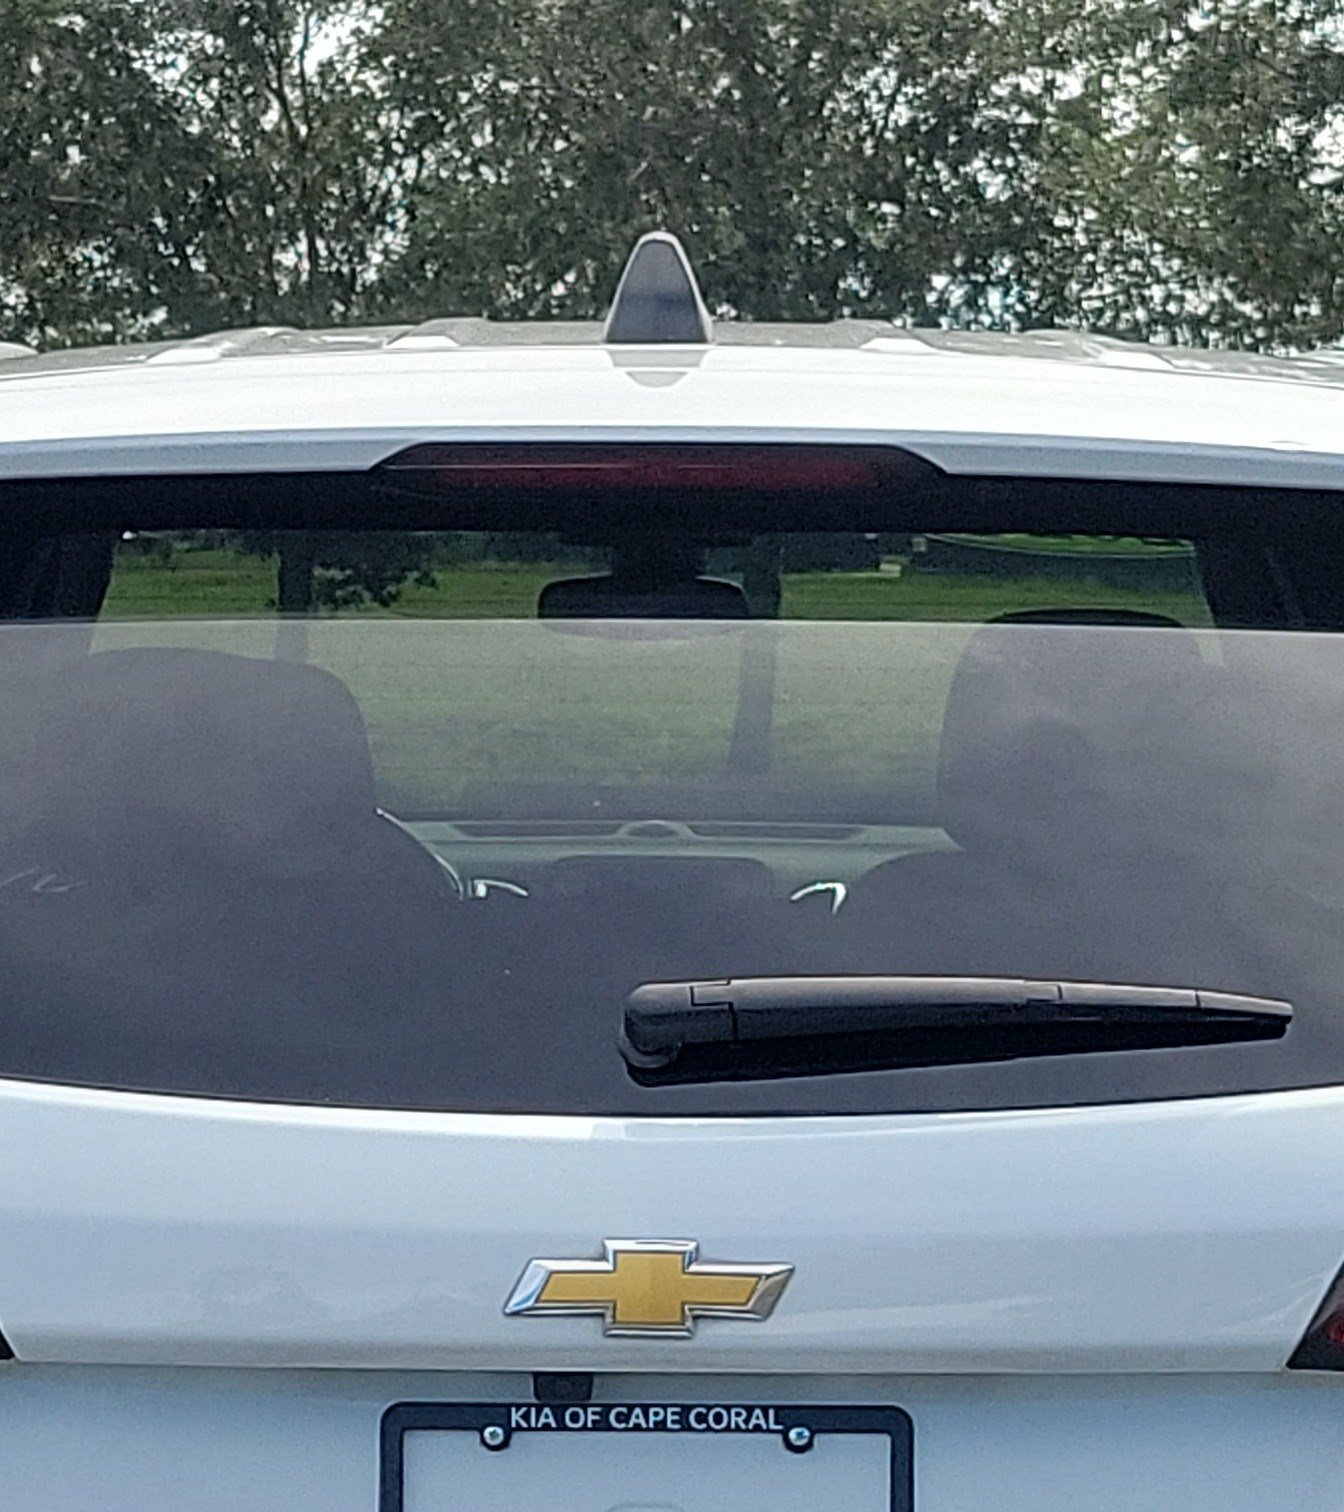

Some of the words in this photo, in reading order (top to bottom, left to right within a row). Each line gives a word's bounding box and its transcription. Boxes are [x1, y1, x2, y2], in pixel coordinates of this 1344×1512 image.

[510, 1407, 556, 1429] KIA
[564, 1407, 601, 1429] OF
[609, 1407, 681, 1430] CAPE
[689, 1408, 784, 1431] CORAL
